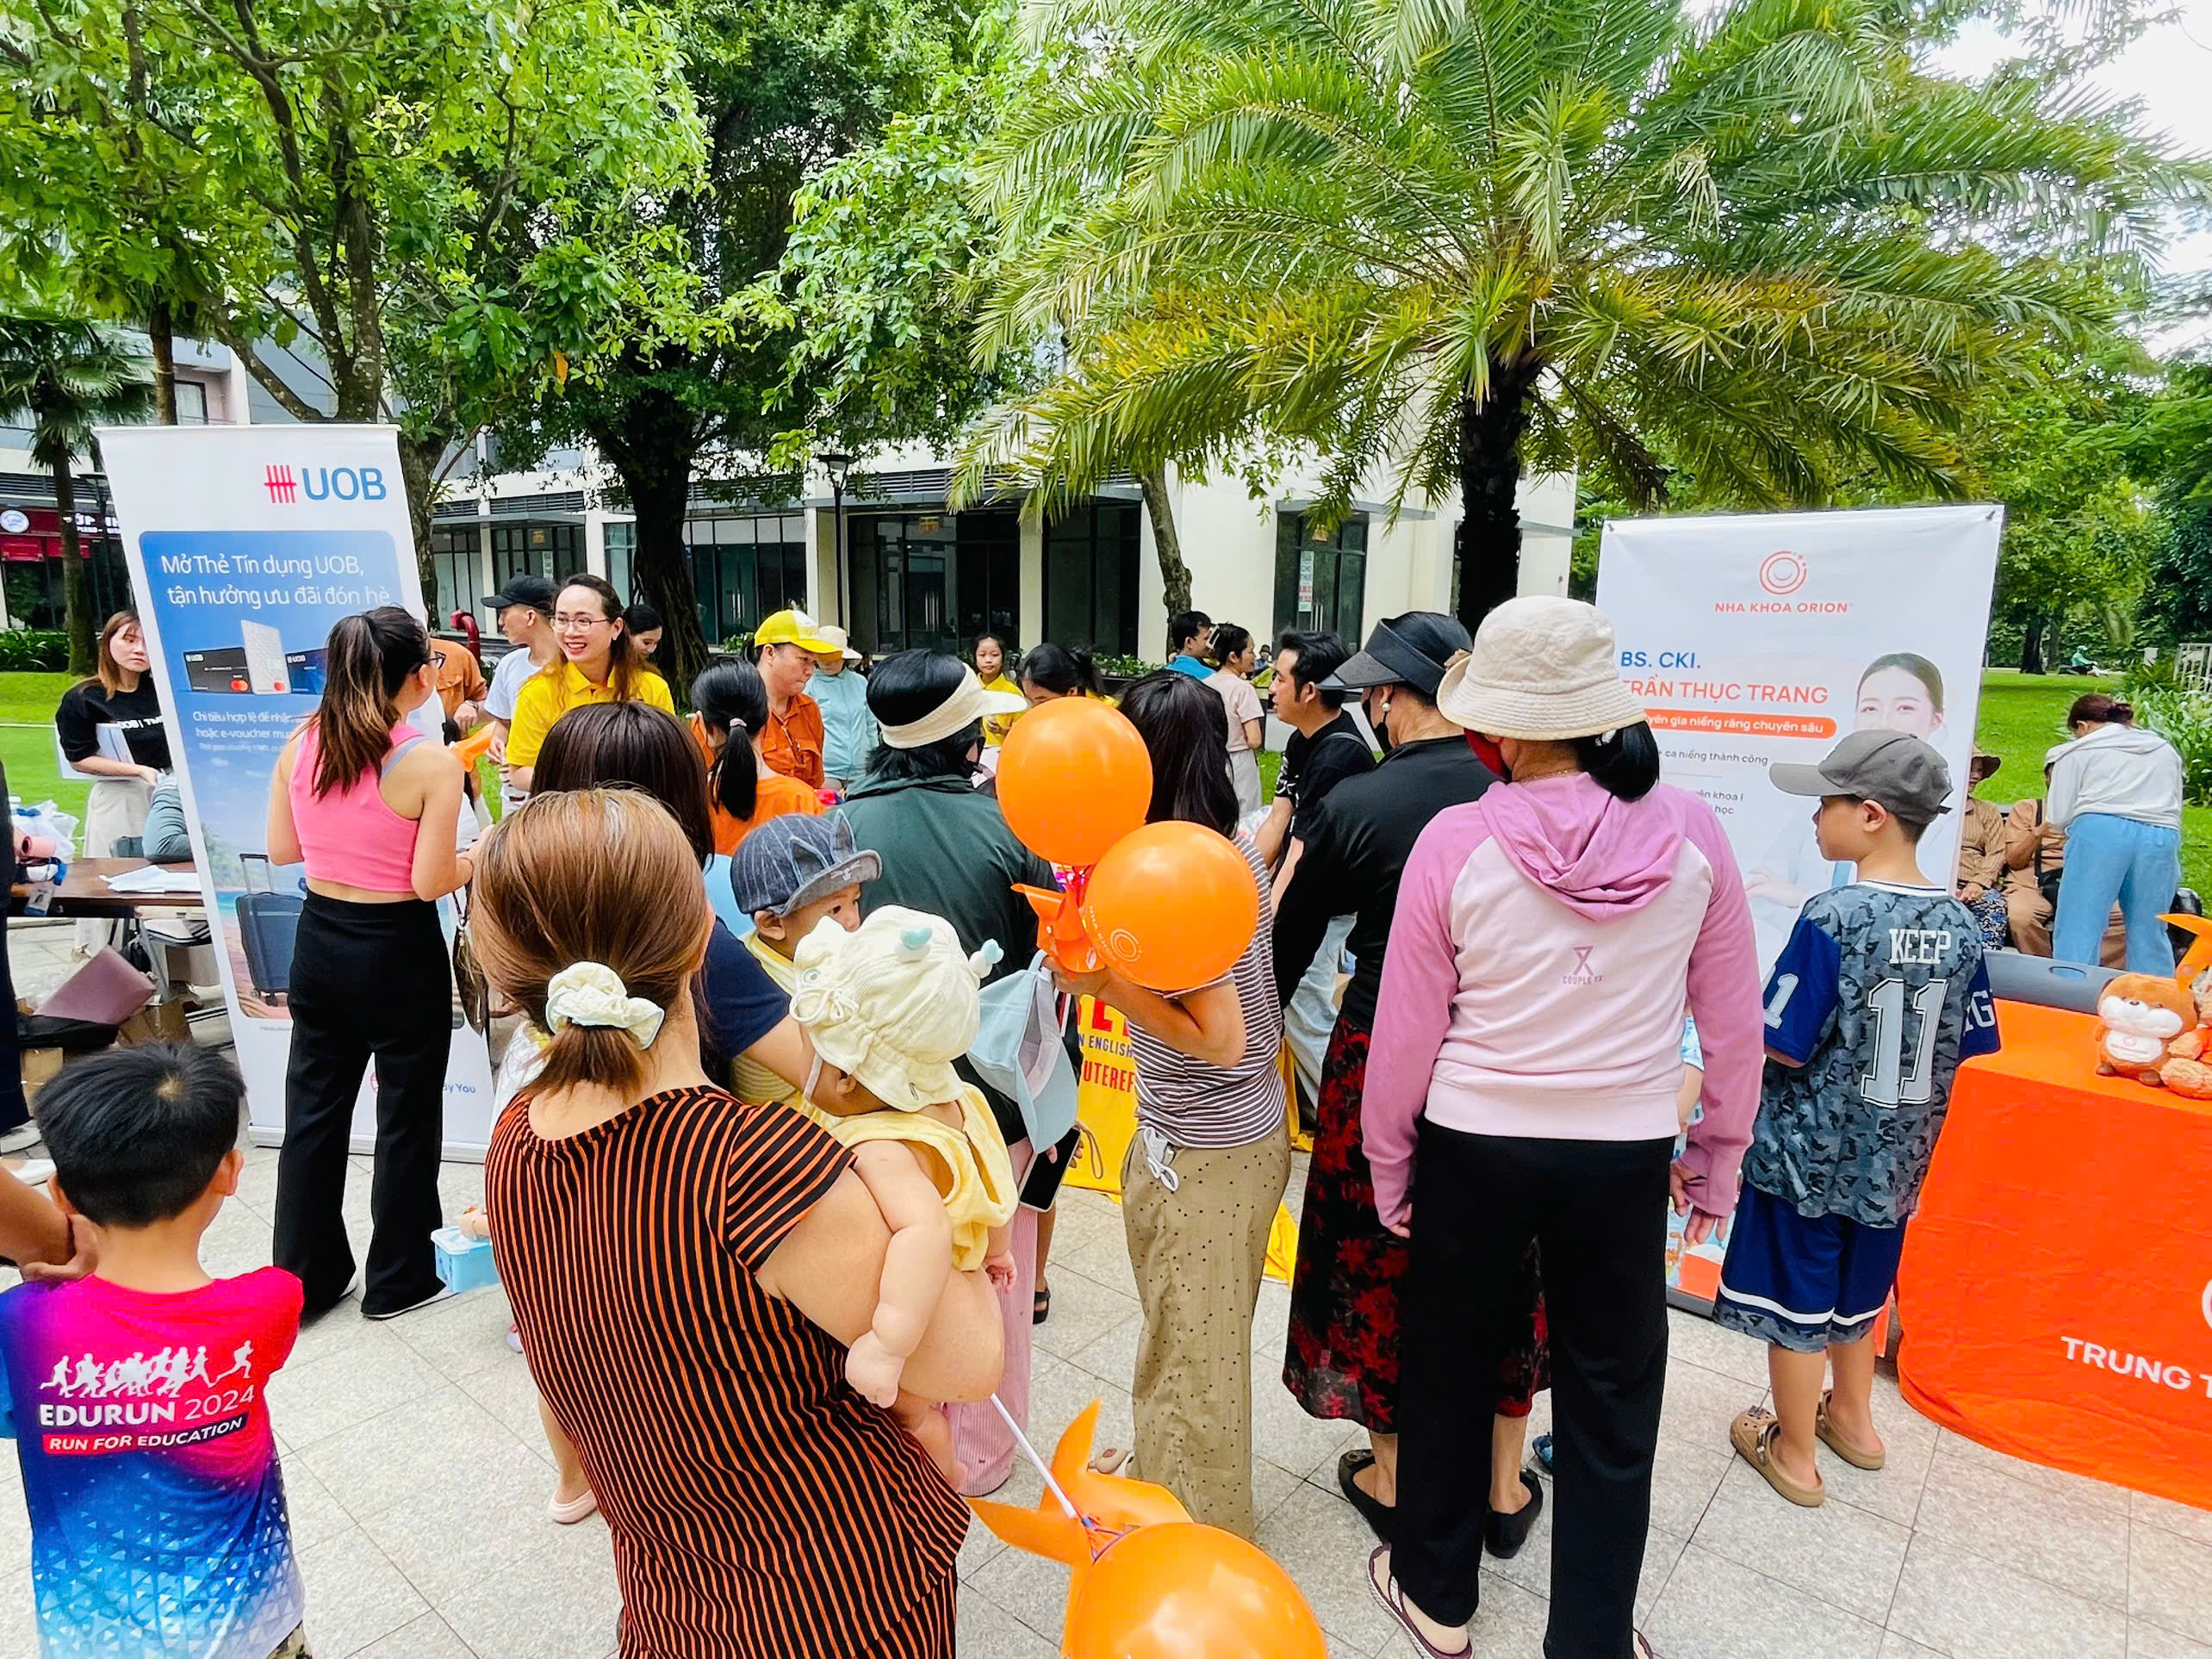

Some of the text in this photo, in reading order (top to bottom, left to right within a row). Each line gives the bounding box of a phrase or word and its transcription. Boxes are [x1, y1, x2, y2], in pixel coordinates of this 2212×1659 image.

[301, 467, 387, 500] UOB
[161, 553, 363, 580] Mở Thẻ Tín dụng UOB,
[167, 585, 196, 608] tận
[199, 584, 261, 609] hưởng
[264, 587, 290, 605] ưu
[294, 585, 321, 605] đãi
[325, 586, 360, 606] đón
[1714, 602, 1849, 613] NHA KHOA ORION
[1620, 651, 1701, 669] BS. CKI.
[1680, 681, 1741, 703] THỤC
[1747, 684, 1829, 705] TRANG
[1670, 715, 1687, 727] gia
[1753, 719, 1799, 733] chuyên
[1800, 721, 1824, 733] sâu
[1710, 752, 1740, 762] thành
[1742, 754, 1768, 767] công
[1712, 789, 1738, 801] khoa
[1714, 805, 1735, 816] học
[1889, 928, 1952, 965] KEEP
[1088, 1035, 1134, 1059] ENGLISH
[1860, 977, 1949, 1109] 11
[455, 1083, 476, 1094] You
[2060, 1336, 2192, 1390] TRUNG
[40, 1385, 255, 1427] EDURUN 2024
[49, 1417, 243, 1451] RUN FOR EDUCATION
